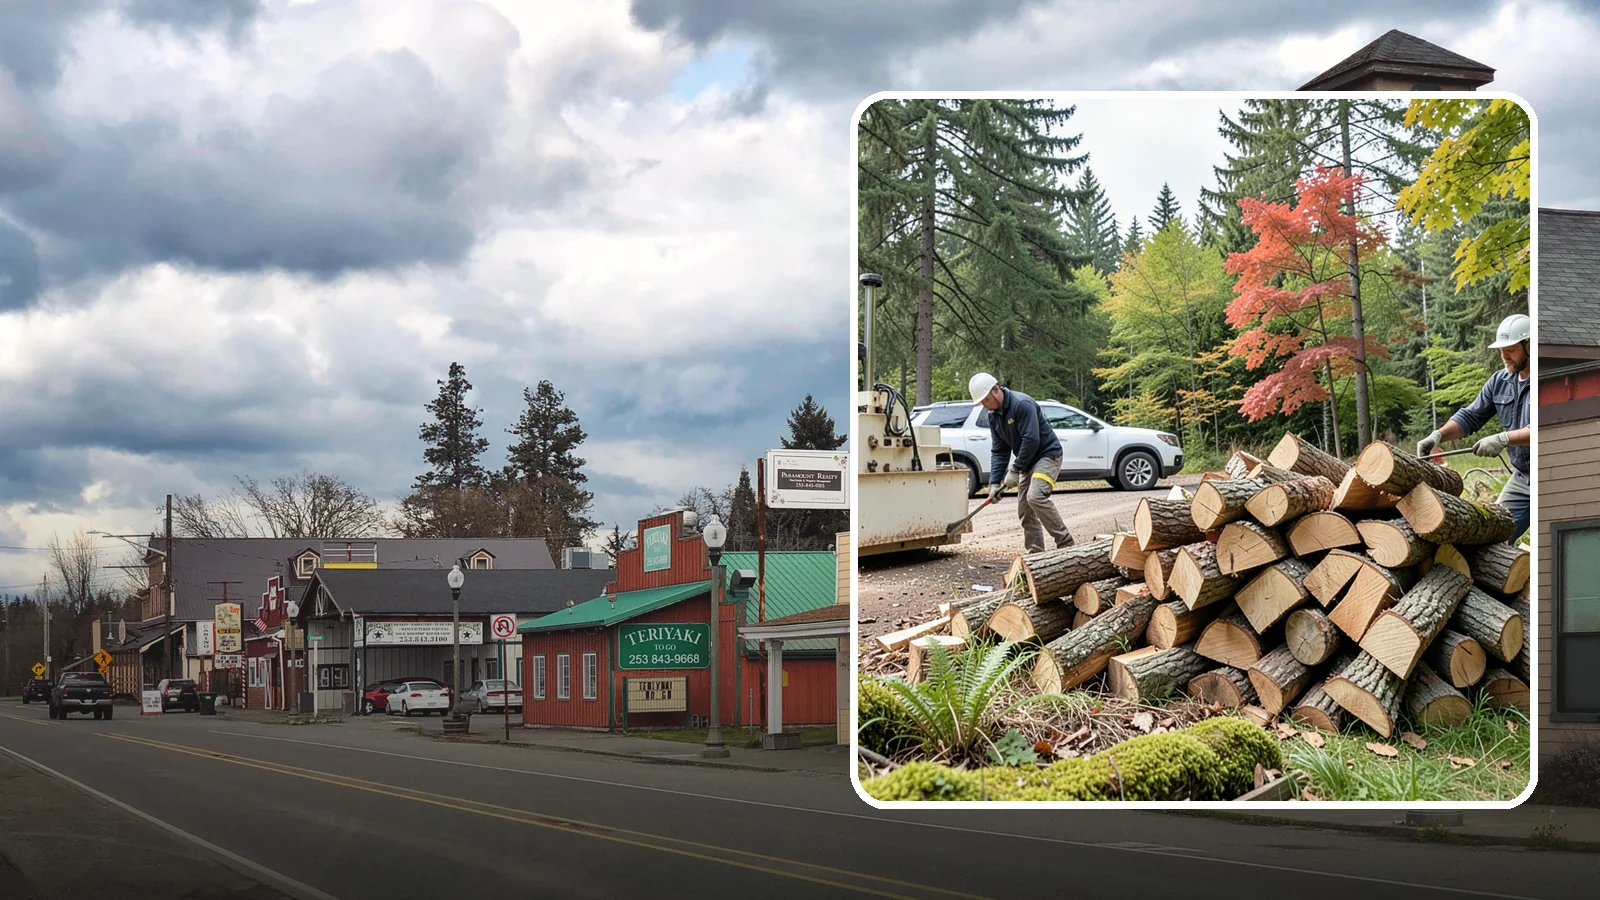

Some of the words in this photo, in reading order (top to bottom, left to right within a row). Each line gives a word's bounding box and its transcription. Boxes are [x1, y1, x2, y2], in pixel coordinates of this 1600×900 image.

[625, 628, 702, 645] TERIYAKI
[629, 654, 648, 664] 253
[652, 654, 700, 664] 843-9668
